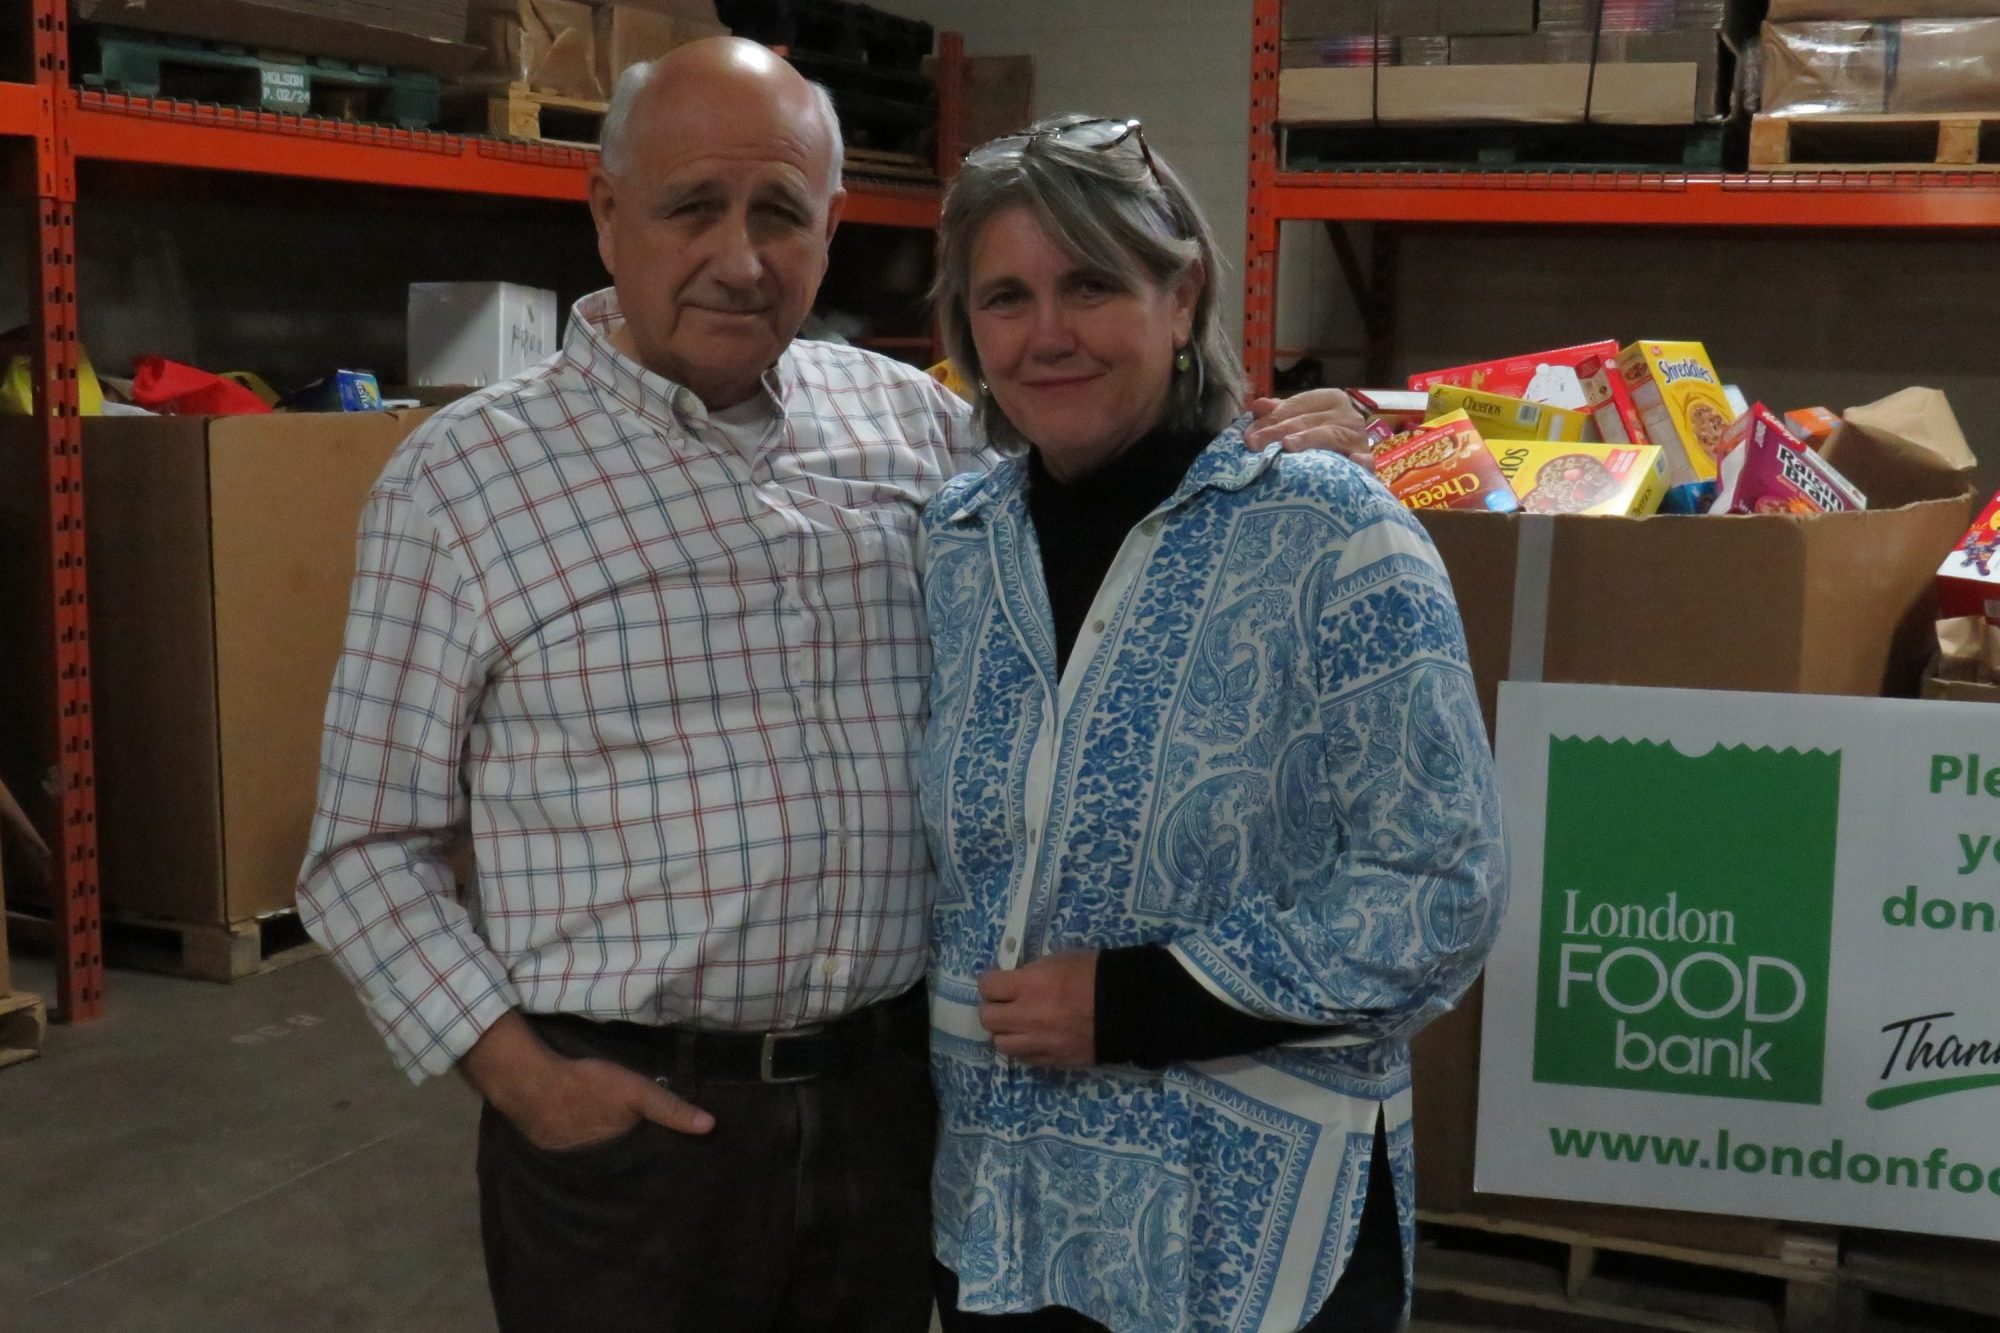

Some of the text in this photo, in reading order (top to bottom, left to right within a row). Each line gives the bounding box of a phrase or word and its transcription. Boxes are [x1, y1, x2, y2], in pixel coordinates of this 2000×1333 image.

[262, 71, 304, 88] MOLSON
[1658, 358, 1716, 385] Shreddies
[1462, 396, 1501, 416] Cheerios
[1778, 446, 1844, 511] Raisin
[1784, 463, 1835, 511] Bran
[1957, 833, 2000, 876] y
[1564, 889, 1736, 945] London
[1882, 885, 2000, 932] don
[1558, 943, 1806, 1023] FOOD
[1615, 1019, 1773, 1080] bank
[1880, 1011, 2000, 1081] Than
